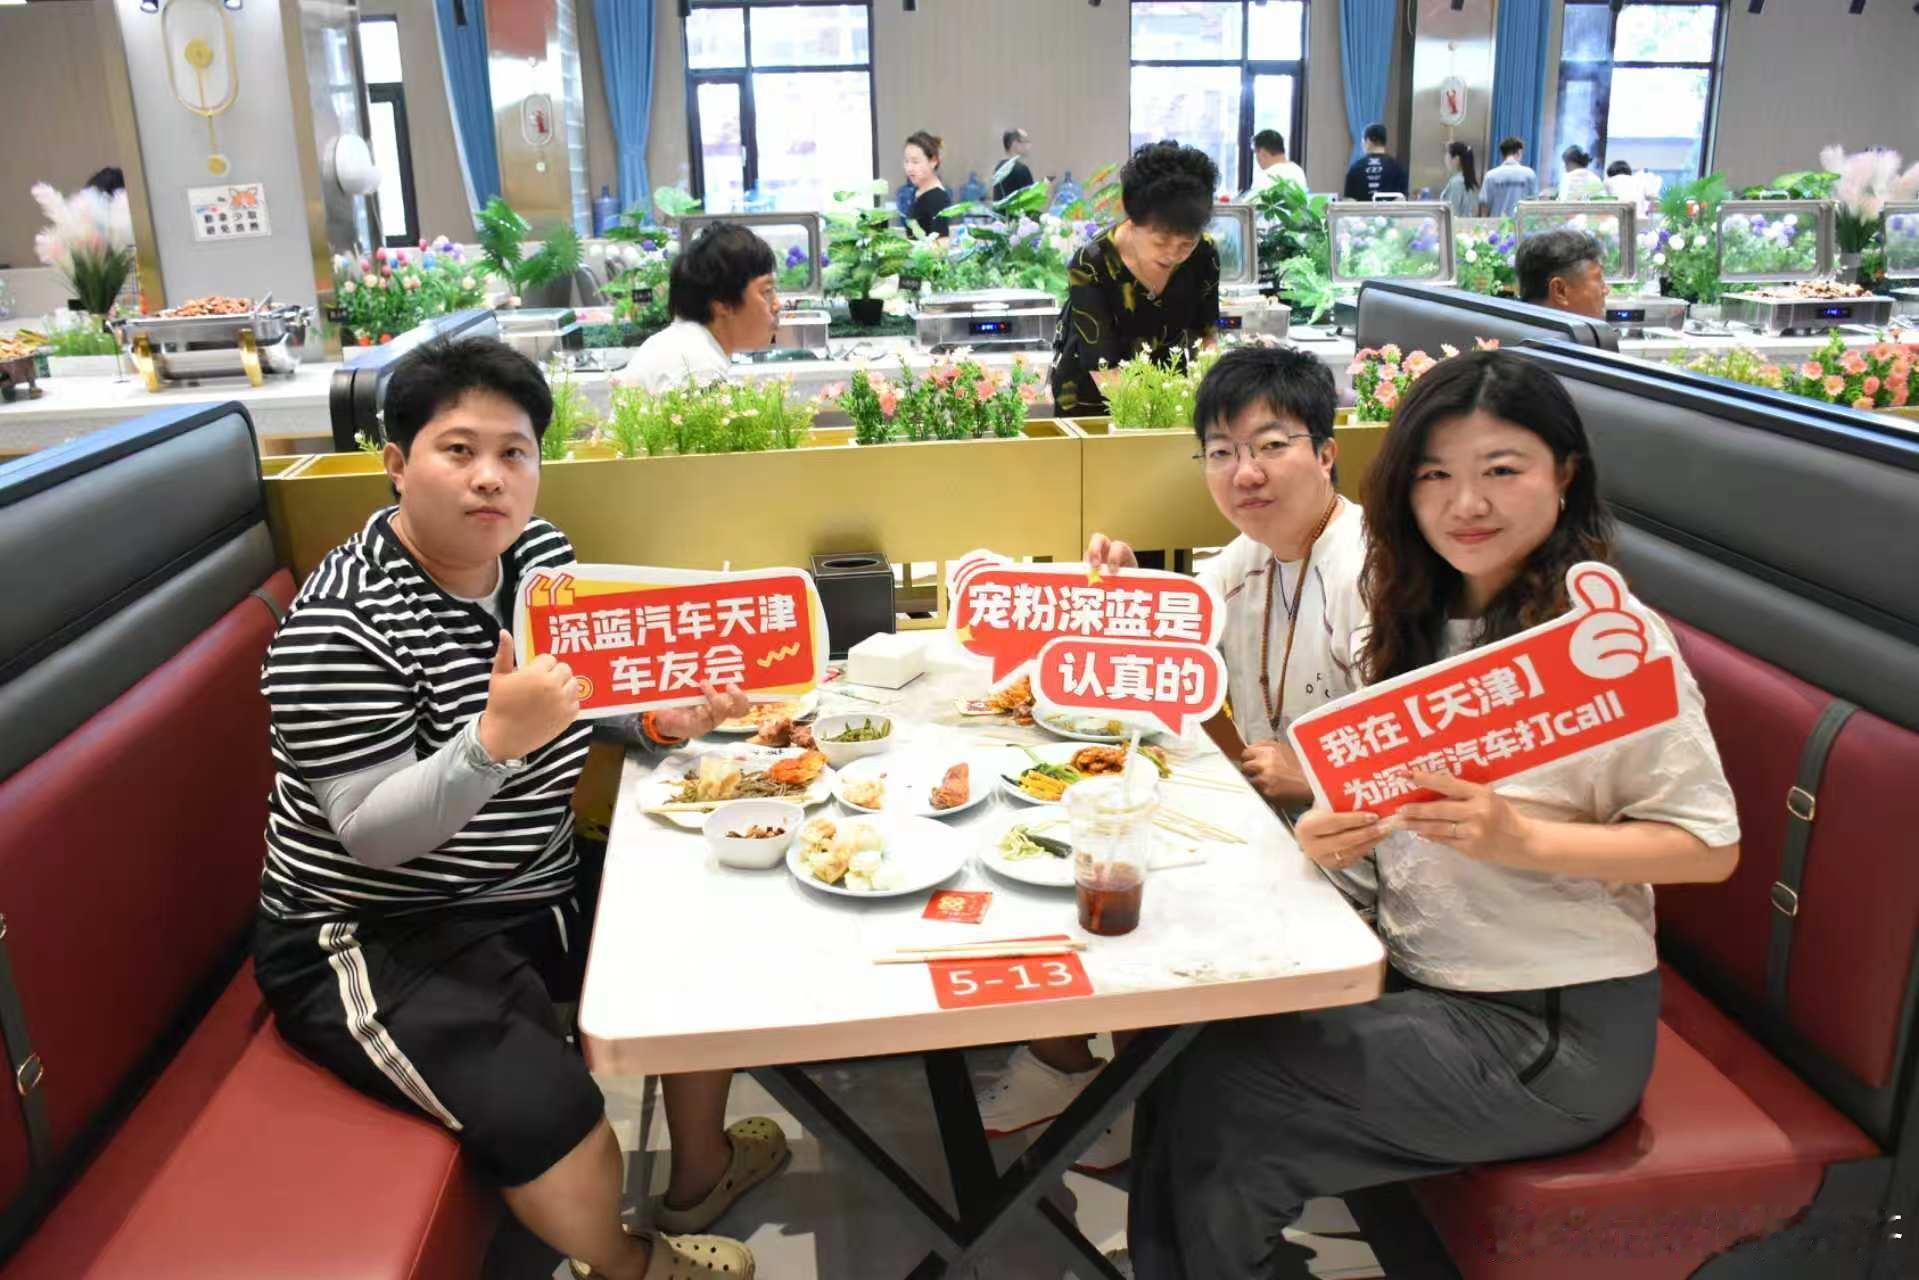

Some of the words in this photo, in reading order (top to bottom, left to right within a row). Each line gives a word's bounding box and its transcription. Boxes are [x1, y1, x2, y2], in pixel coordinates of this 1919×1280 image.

[548, 593, 797, 655] 深蓝汽车天津
[968, 581, 1202, 640] 宠粉深蓝是
[610, 644, 745, 696] 车友会
[1059, 651, 1205, 705] 认真的
[1320, 653, 1544, 768] 我在【天津】
[948, 960, 1073, 996] 5-13
